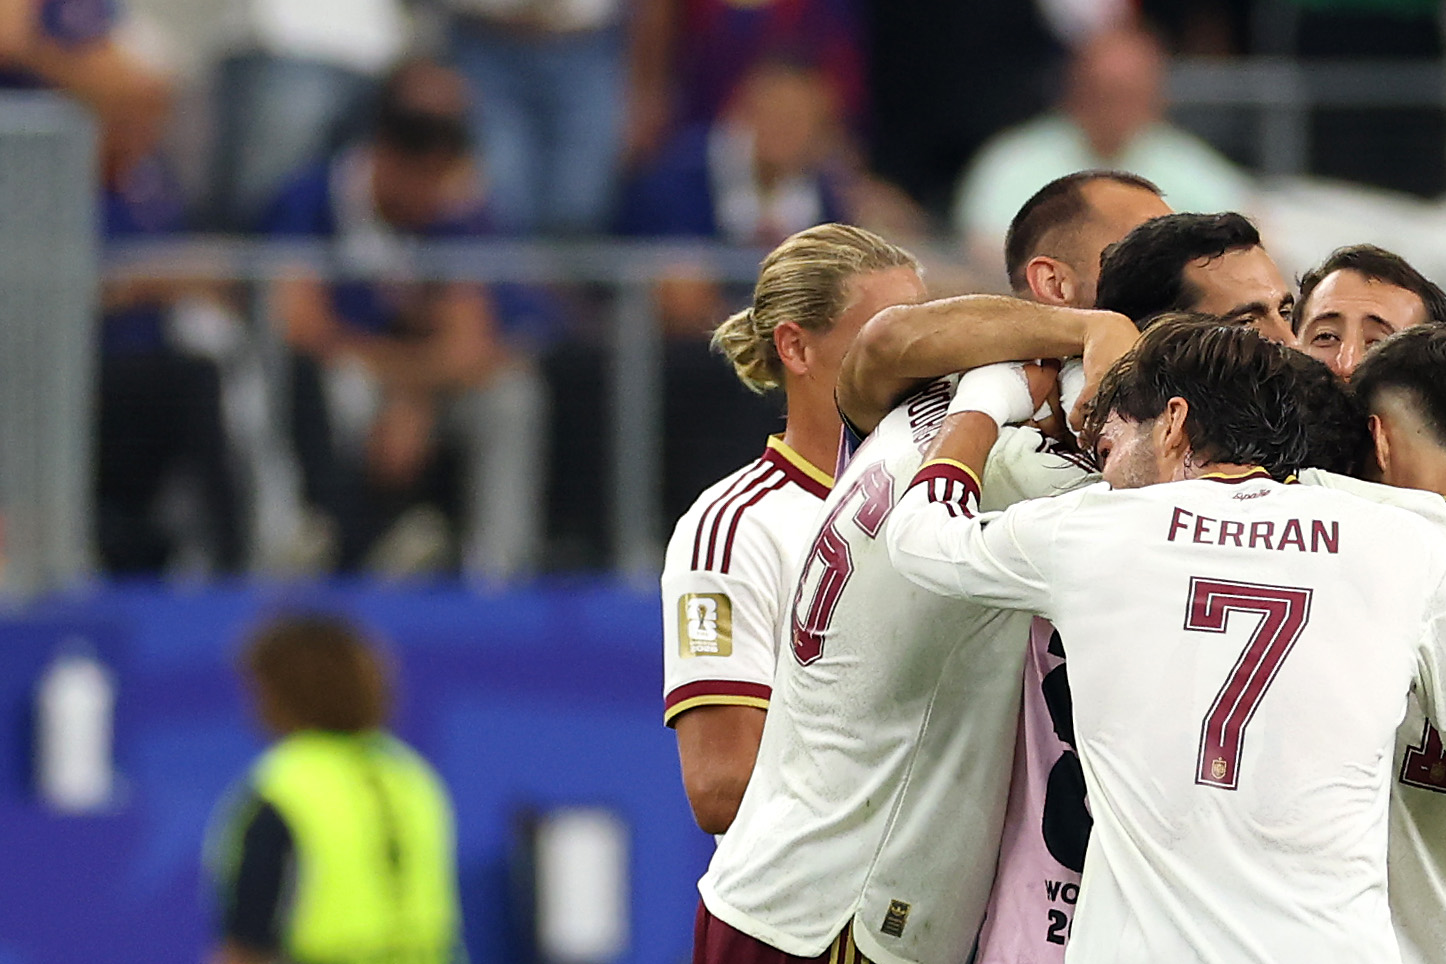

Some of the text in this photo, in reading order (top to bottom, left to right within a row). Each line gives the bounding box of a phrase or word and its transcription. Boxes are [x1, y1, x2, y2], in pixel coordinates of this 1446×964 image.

[1167, 506, 1339, 554] FERRAN
[1183, 576, 1313, 792] 7
[1046, 909, 1075, 945] 2
